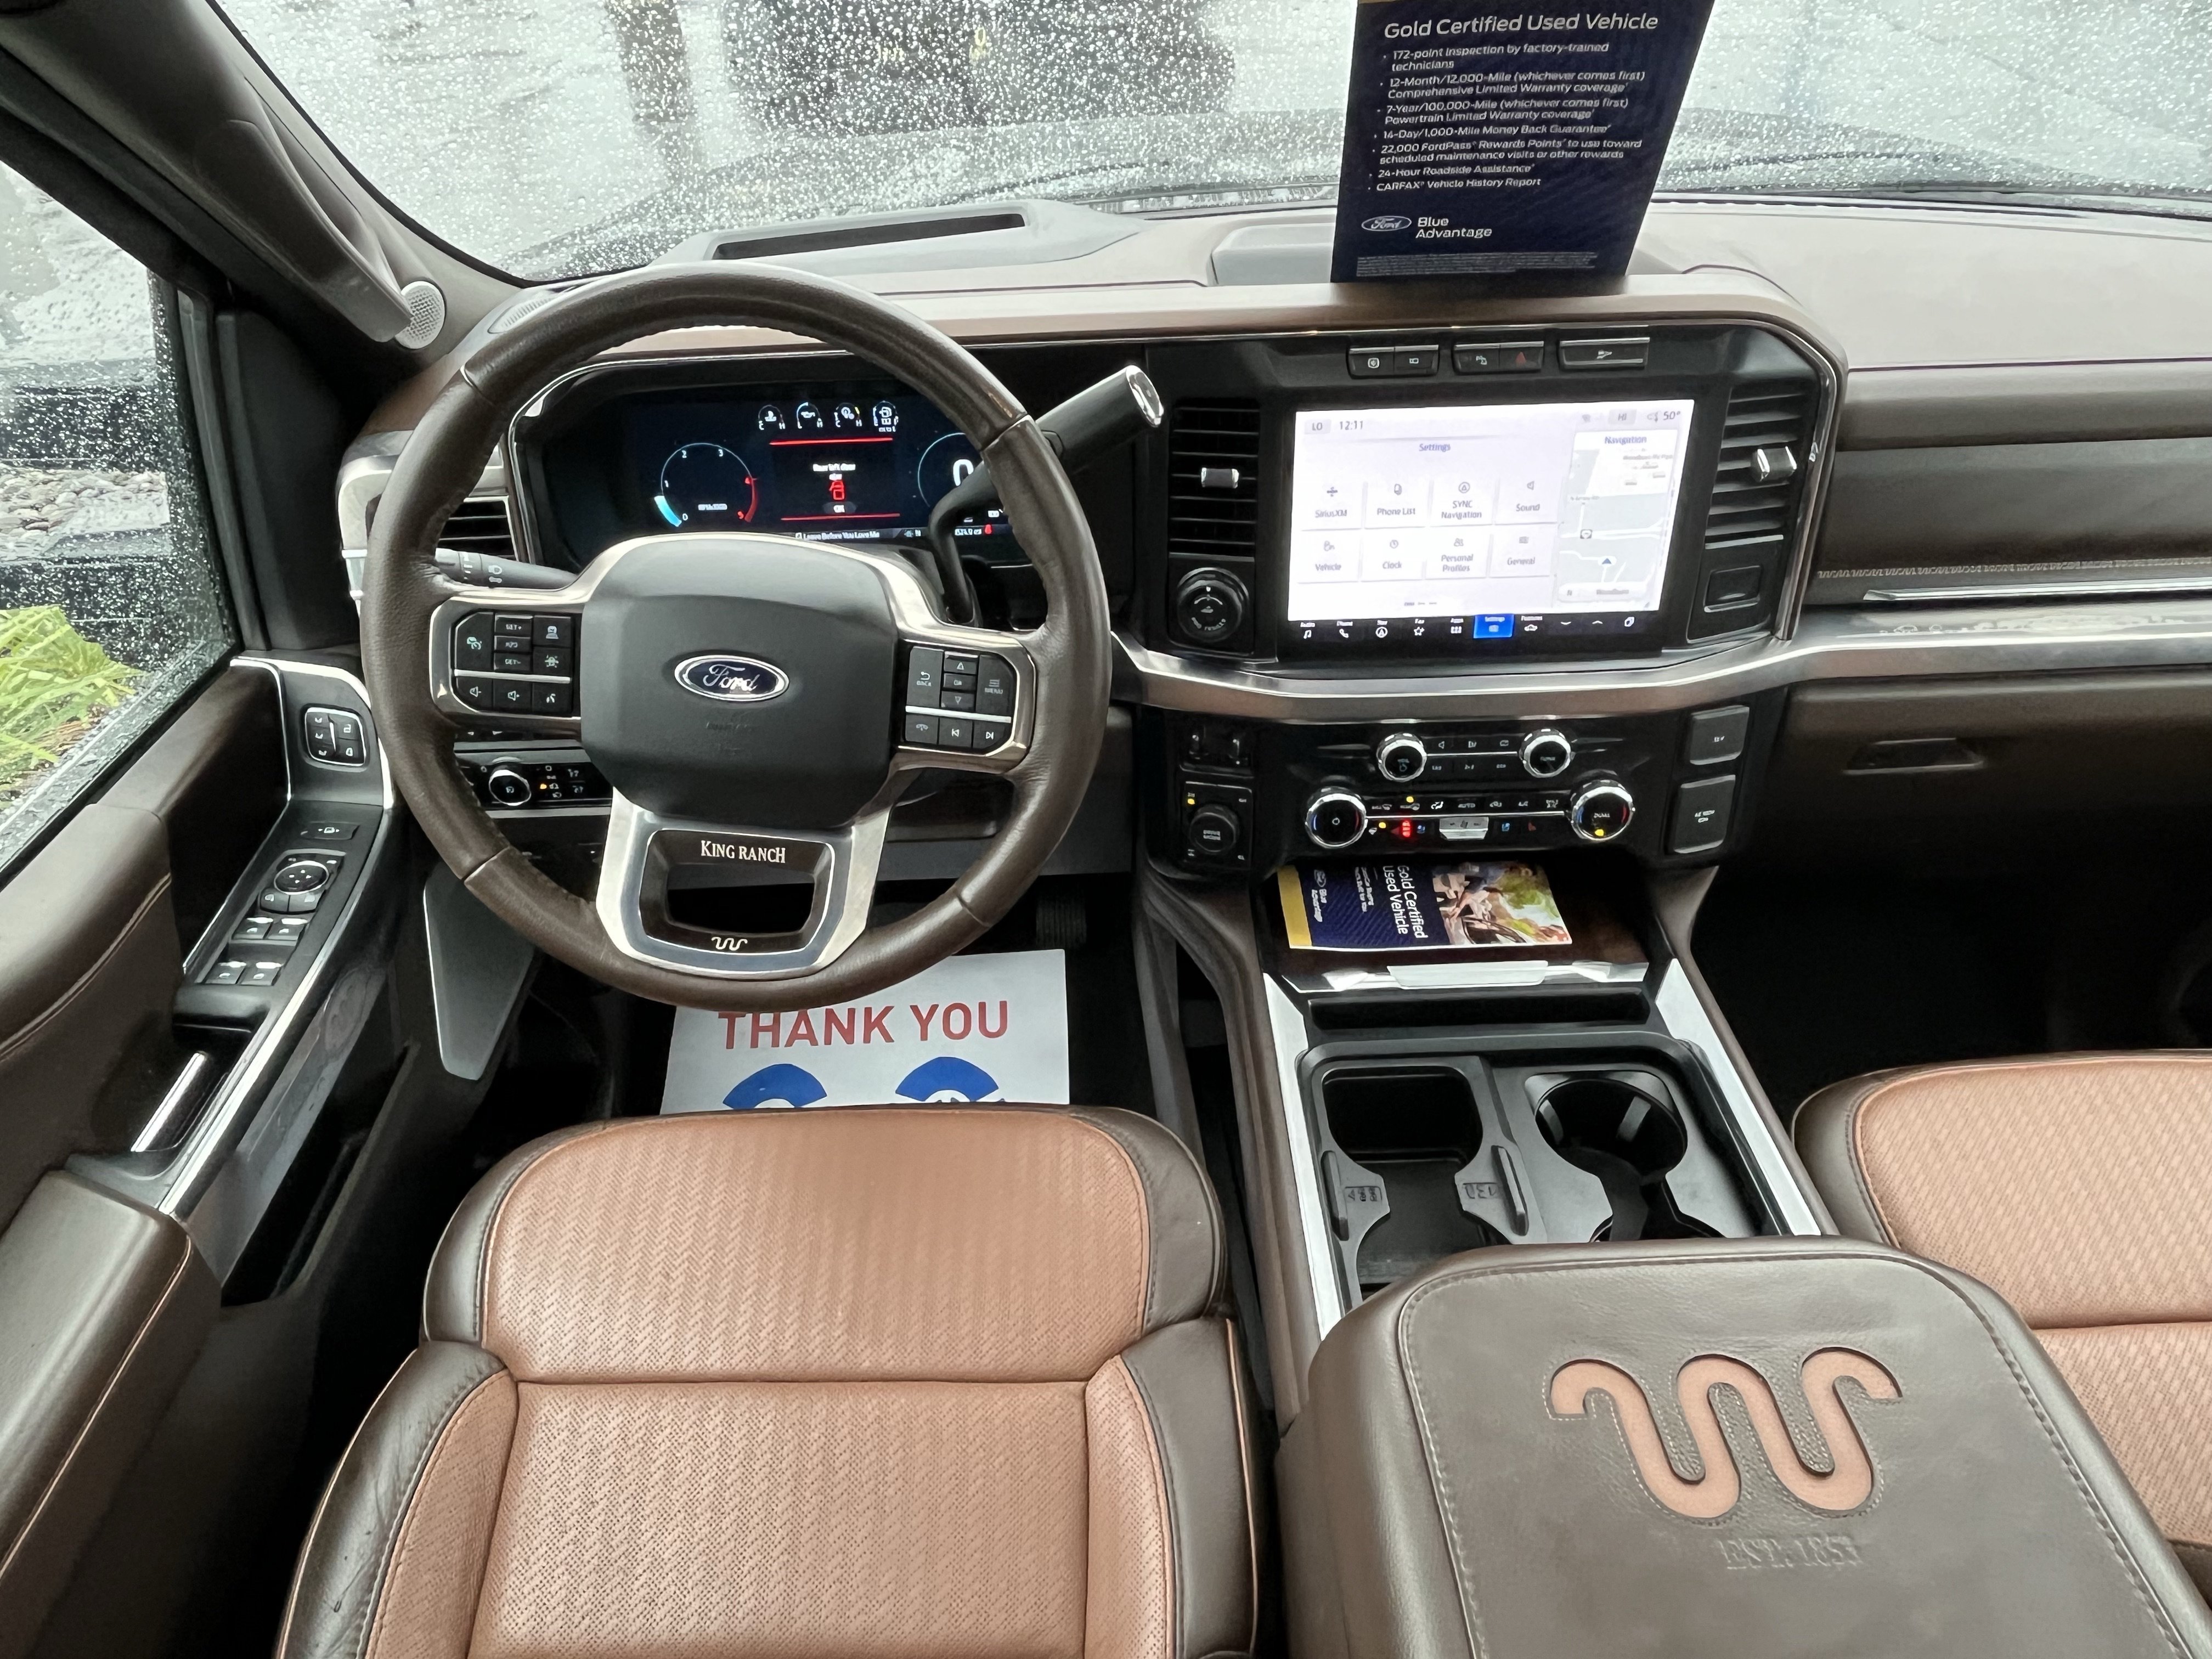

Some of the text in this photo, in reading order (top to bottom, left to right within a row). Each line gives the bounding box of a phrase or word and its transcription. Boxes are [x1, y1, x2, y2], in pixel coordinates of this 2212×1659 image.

[1384, 13, 1658, 38] Gold Certified Used Vehicle
[1393, 47, 1443, 60] 172-point
[1507, 44, 1521, 55] by
[1523, 42, 1610, 54] factory-trained
[1392, 60, 1454, 72] technicians
[1514, 71, 1576, 81] (whichever
[1577, 72, 1616, 81] comes
[1618, 71, 1645, 81] first)
[1388, 86, 1474, 99] Comprehensive
[1476, 83, 1518, 94] Limited
[1520, 83, 1572, 94] Warranty
[1499, 99, 1560, 109] (whichever
[1562, 99, 1599, 108] comes
[1602, 98, 1628, 109] first)
[1385, 113, 1444, 125] Powertrain
[1446, 111, 1488, 122] Limited
[1489, 110, 1539, 121] Warranty
[1482, 125, 1520, 136] Money
[1381, 143, 1419, 154] 22,000
[1479, 140, 1526, 149] Rewards
[1567, 139, 1578, 147] to
[1602, 139, 1643, 148] toward
[1436, 151, 1505, 161] maintenance
[1549, 150, 1578, 159] other
[1378, 168, 1420, 178] 24-Hour
[1423, 166, 1472, 176] Roadside
[1427, 180, 1464, 188] Vehicle
[1466, 179, 1504, 188] History
[1505, 178, 1541, 188] Report
[1418, 217, 1449, 227] Blue
[1415, 228, 1492, 239] Advantage
[1339, 420, 1364, 431] 12:11
[1604, 436, 1647, 445] Navigation
[718, 449, 724, 457] 3
[1419, 443, 1451, 453] Settings
[681, 450, 687, 459] 2
[1452, 500, 1473, 509] SYNC
[1515, 503, 1541, 512] Sound
[1314, 509, 1348, 518] SiriusXM
[1376, 506, 1416, 516] Phone List
[1441, 510, 1482, 520] Navigation
[682, 513, 689, 521] 0
[1441, 553, 1474, 563] Personal
[1506, 556, 1536, 566] General
[1314, 563, 1342, 572] Vehicle
[1382, 561, 1402, 569] Clock
[1442, 563, 1470, 572] Profiles
[702, 663, 761, 692] Ford
[701, 840, 786, 864] KING RANCH
[1383, 865, 1410, 935] Used Vehicle
[1397, 865, 1429, 939] Gold Certified
[718, 1000, 1009, 1050] THANK YOU
